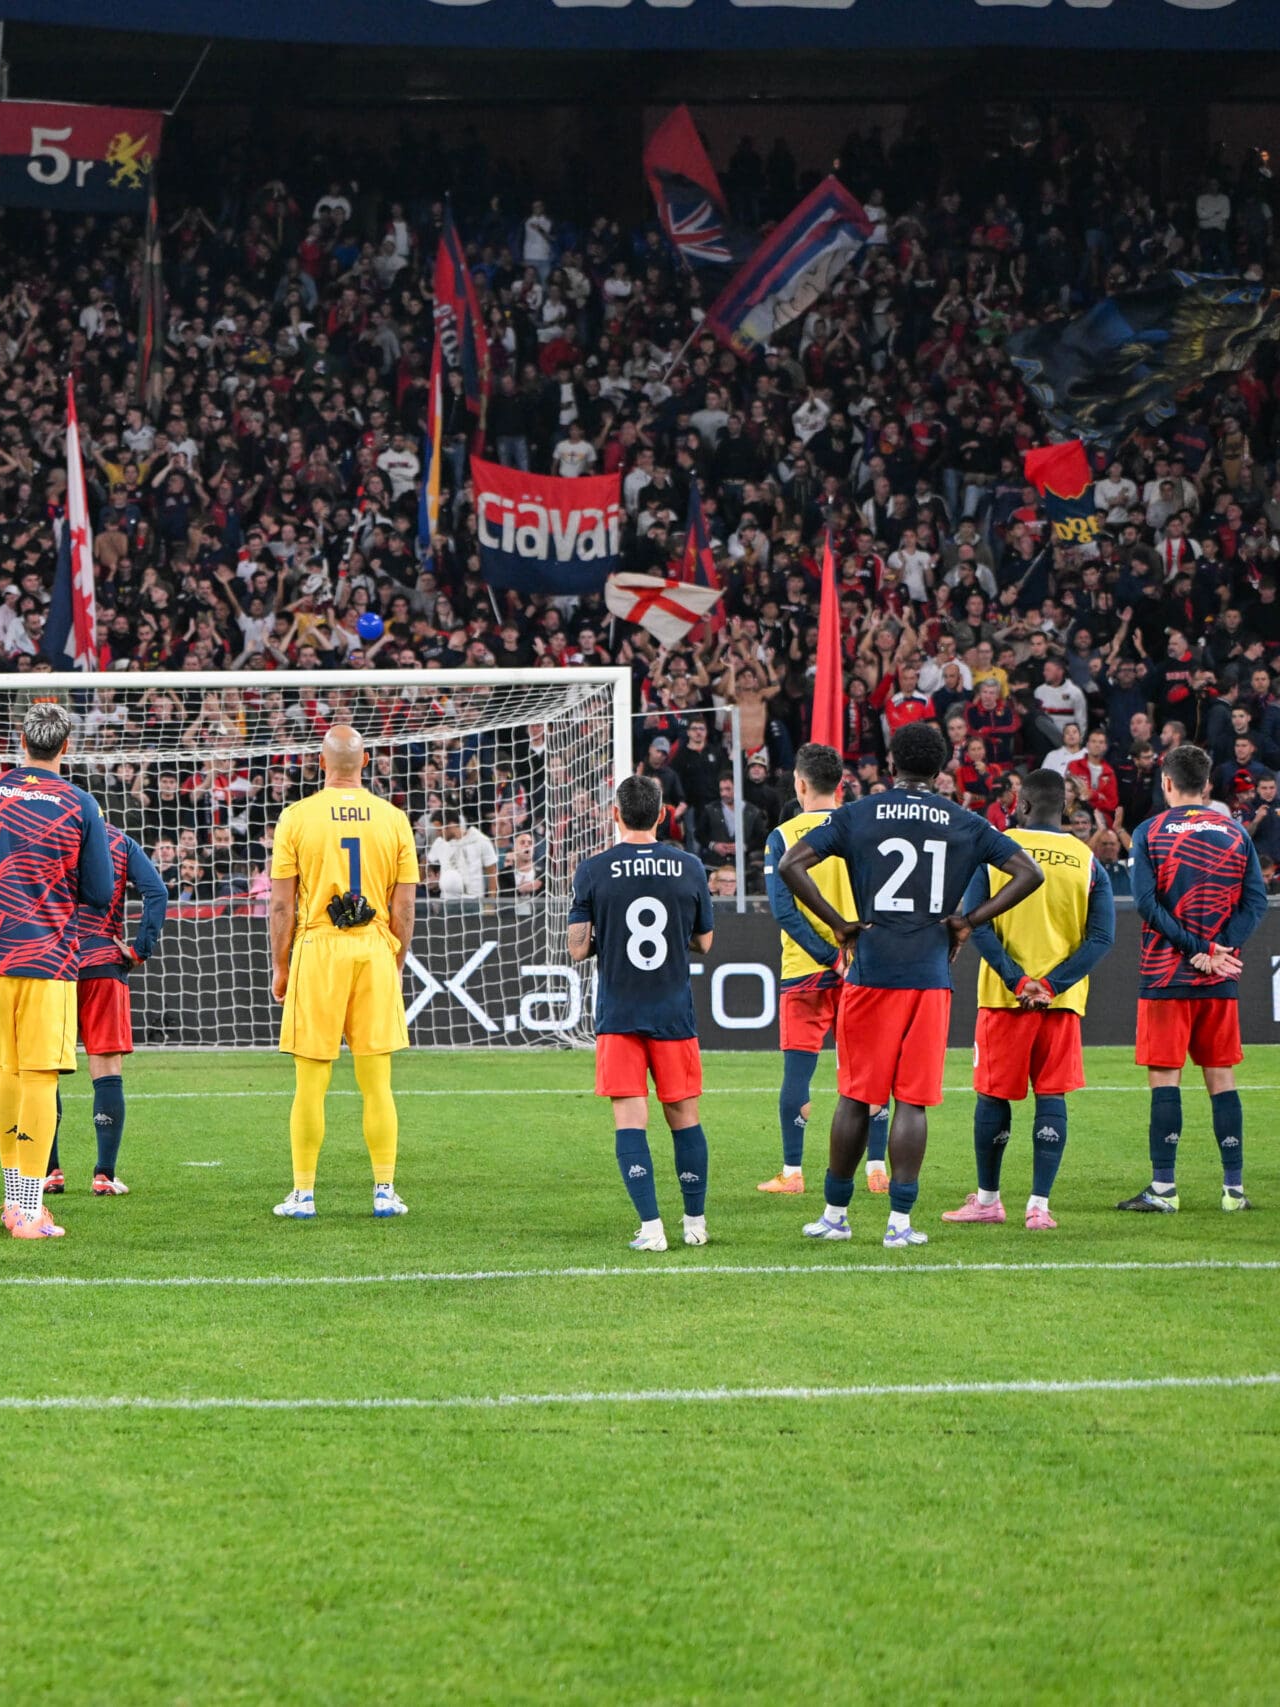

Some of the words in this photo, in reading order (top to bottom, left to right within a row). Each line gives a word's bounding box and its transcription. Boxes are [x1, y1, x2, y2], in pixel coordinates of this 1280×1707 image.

[330, 806, 371, 822] LEALI
[876, 803, 951, 826] EKHATOR
[340, 837, 362, 900] 1
[610, 856, 683, 878] STANCIU
[874, 837, 948, 914] 21
[625, 895, 668, 971] 8
